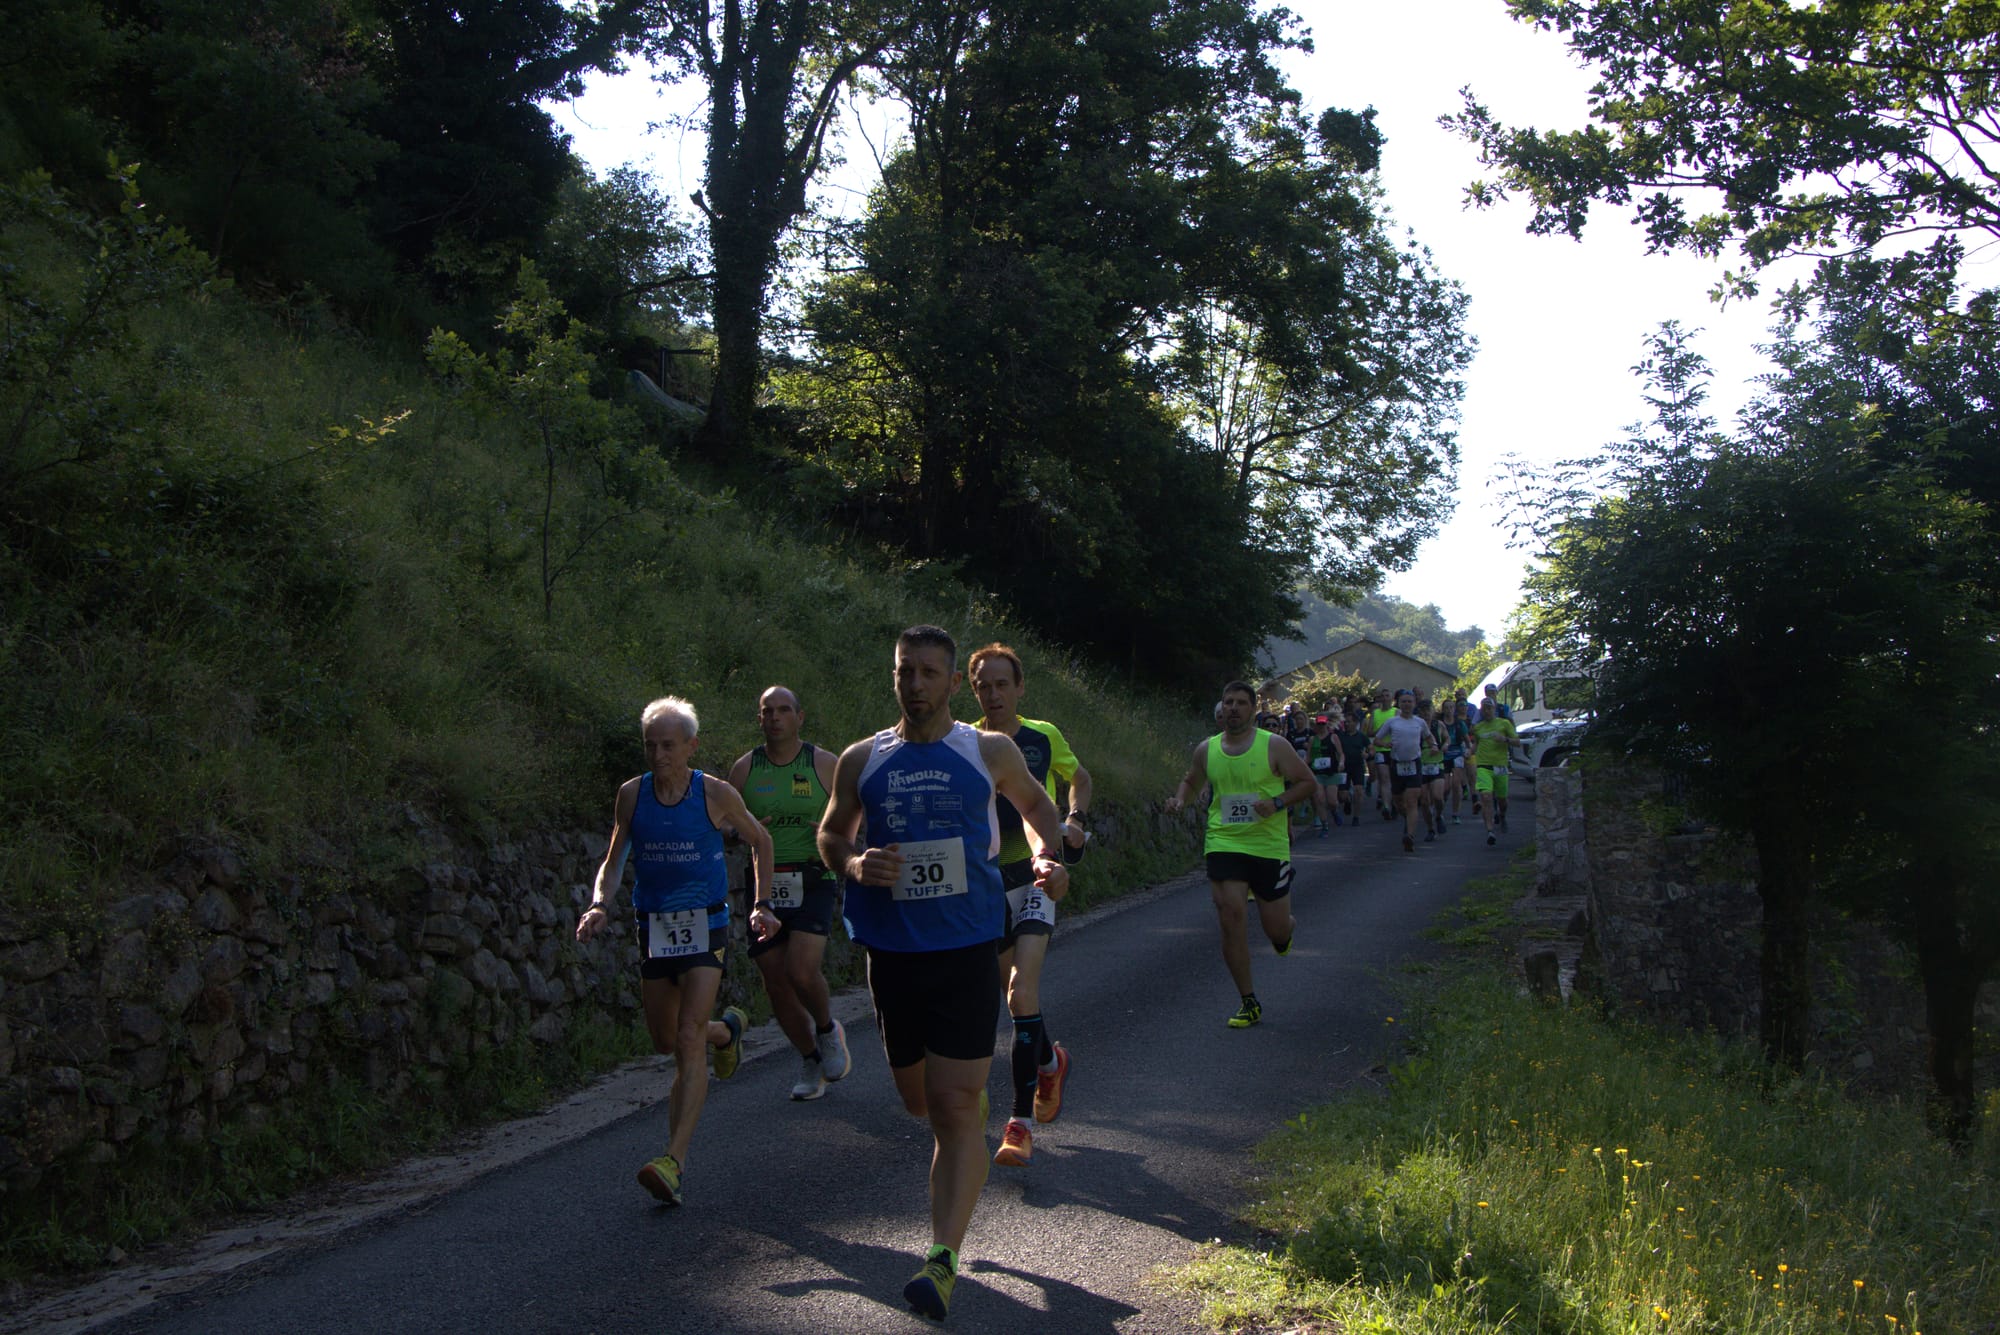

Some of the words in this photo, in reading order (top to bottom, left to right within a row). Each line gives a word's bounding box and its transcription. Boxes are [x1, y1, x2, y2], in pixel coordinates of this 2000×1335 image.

[1231, 805, 1248, 816] 29
[776, 816, 801, 826] ATA
[644, 841, 695, 851] MACADAM
[642, 852, 665, 862] CLUB
[912, 863, 944, 885] 30
[905, 884, 953, 897] TUFF'S
[1020, 896, 1042, 912] 25
[667, 928, 692, 945] 13
[661, 945, 699, 955] TUFF'S
